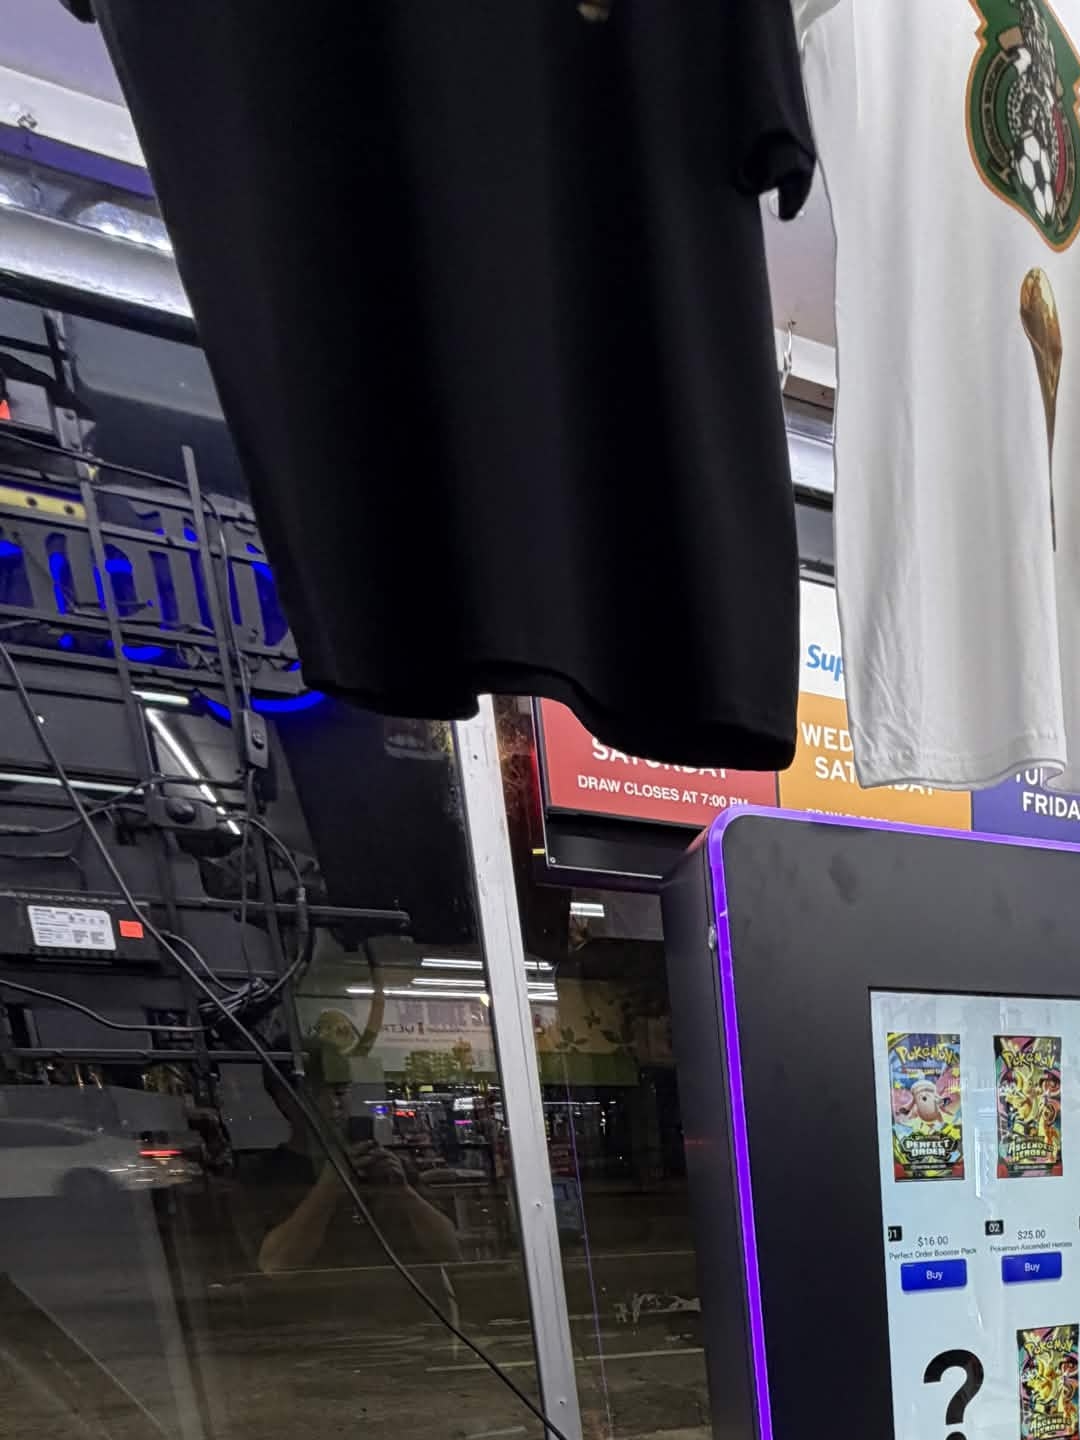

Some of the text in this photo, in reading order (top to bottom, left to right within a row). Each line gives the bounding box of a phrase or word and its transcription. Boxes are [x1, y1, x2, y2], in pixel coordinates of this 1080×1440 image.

[577, 774, 621, 793] DRAW
[624, 781, 679, 802] CLOSES
[682, 790, 698, 804] AT
[701, 793, 727, 808] 7:00
[988, 1222, 1046, 1240] 02 $25.00
[918, 1235, 949, 1248] $16.00
[1024, 1262, 1040, 1273] Buy
[926, 1270, 944, 1281] Buy
